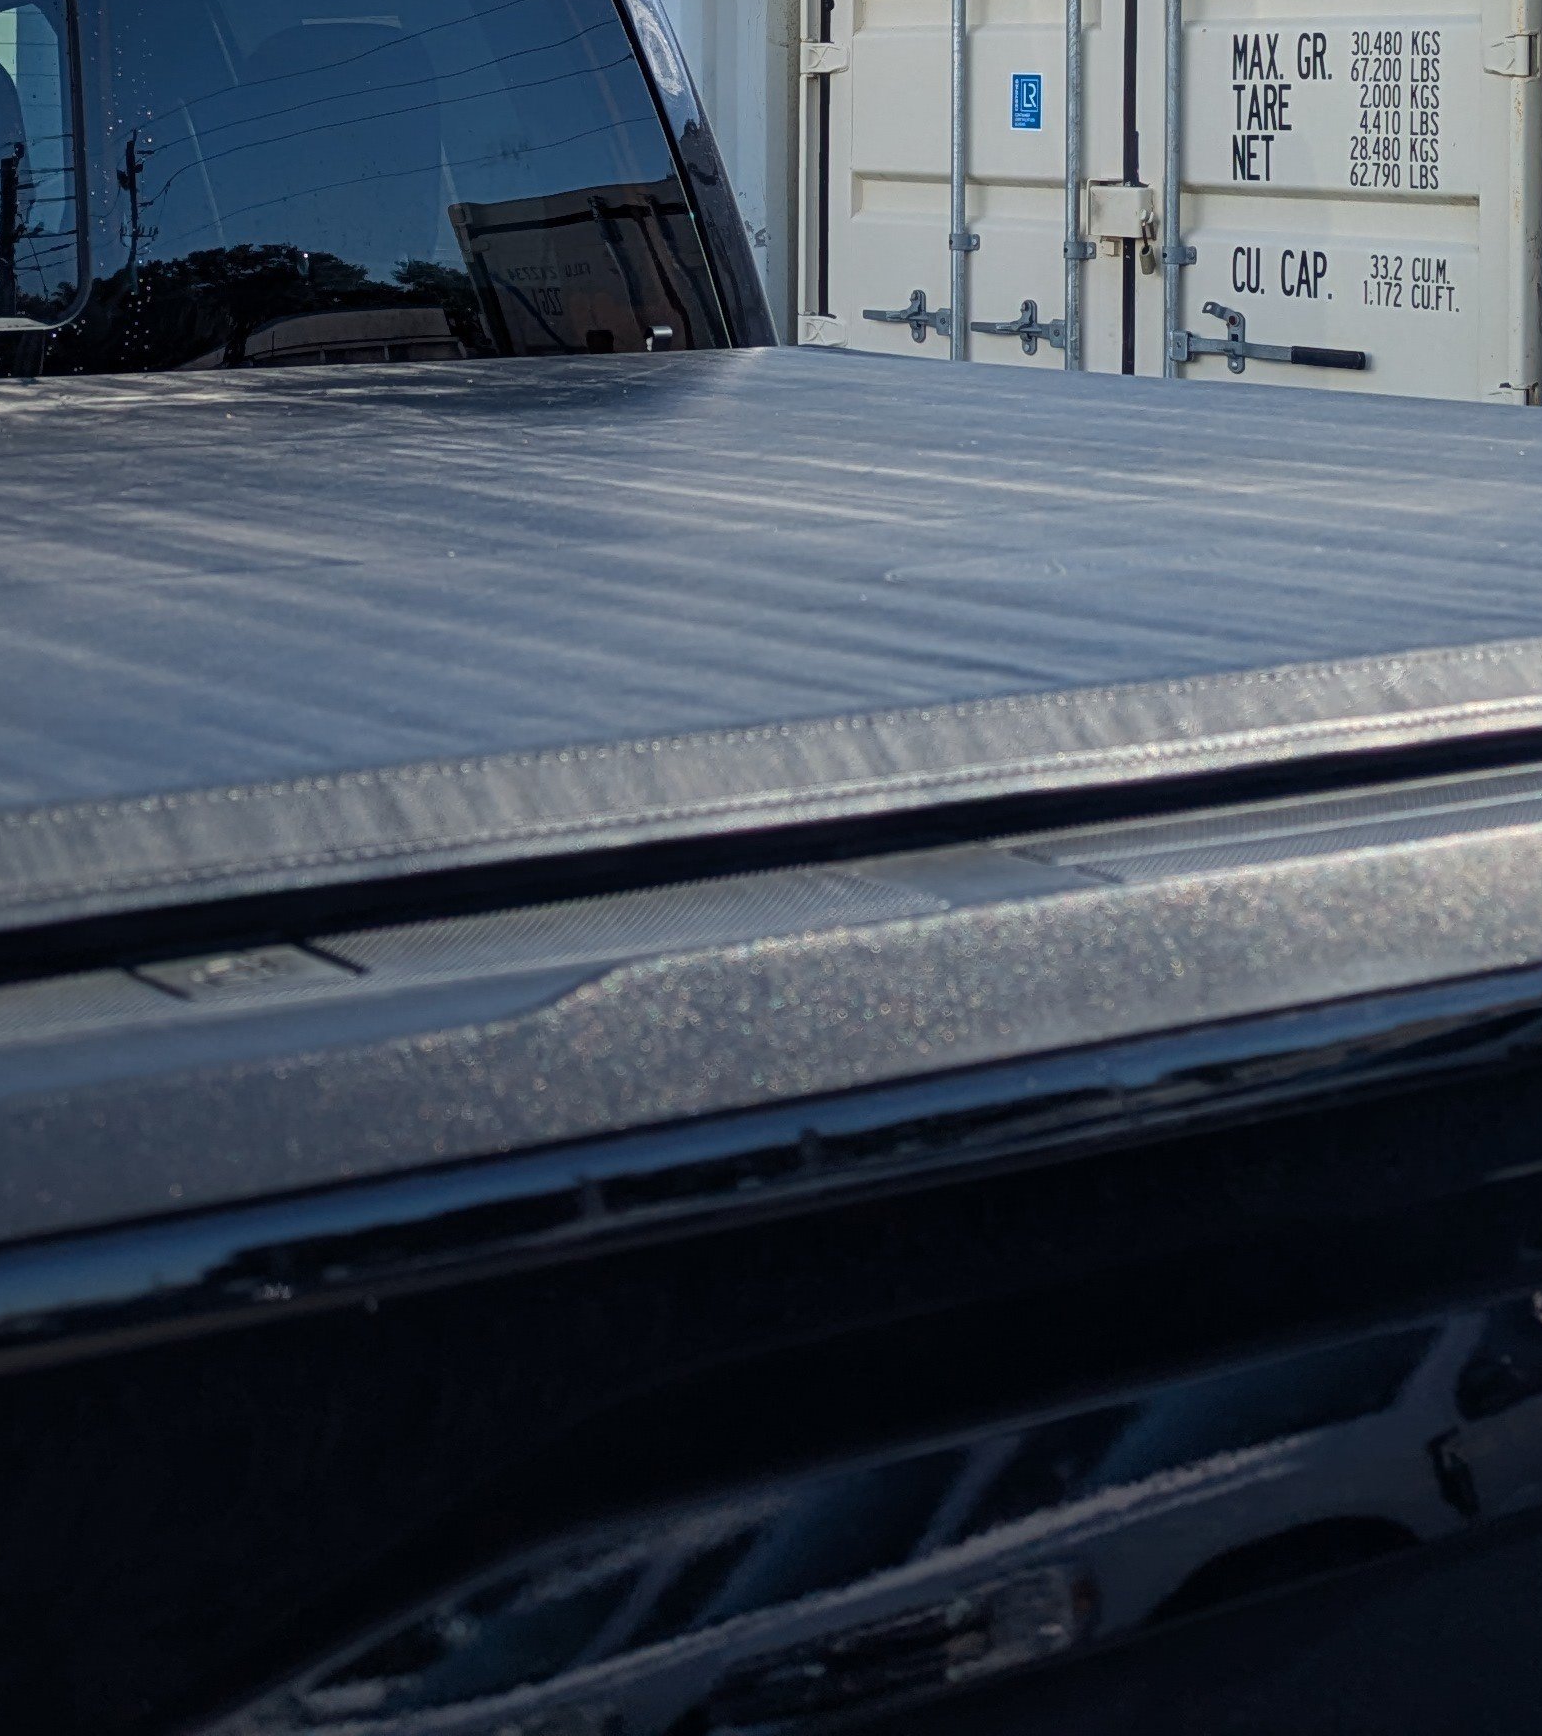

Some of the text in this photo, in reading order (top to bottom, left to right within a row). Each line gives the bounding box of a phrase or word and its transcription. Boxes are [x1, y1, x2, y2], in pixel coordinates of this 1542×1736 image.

[1233, 31, 1440, 80] MAX. GR. 30,480 KGS
[1351, 58, 1439, 82] 67,200 LBS
[1024, 82, 1037, 108] LR
[1233, 84, 1439, 130] TARE 2,000 KGS
[1360, 110, 1439, 136] 4,410 LBS
[1233, 135, 1438, 181] NET 28,480 KGS
[1350, 162, 1438, 189] 62,790 LBS
[1233, 247, 1450, 299] CU. CAP. 33.2 CU.M.
[1412, 284, 1459, 312] CU.FT.
